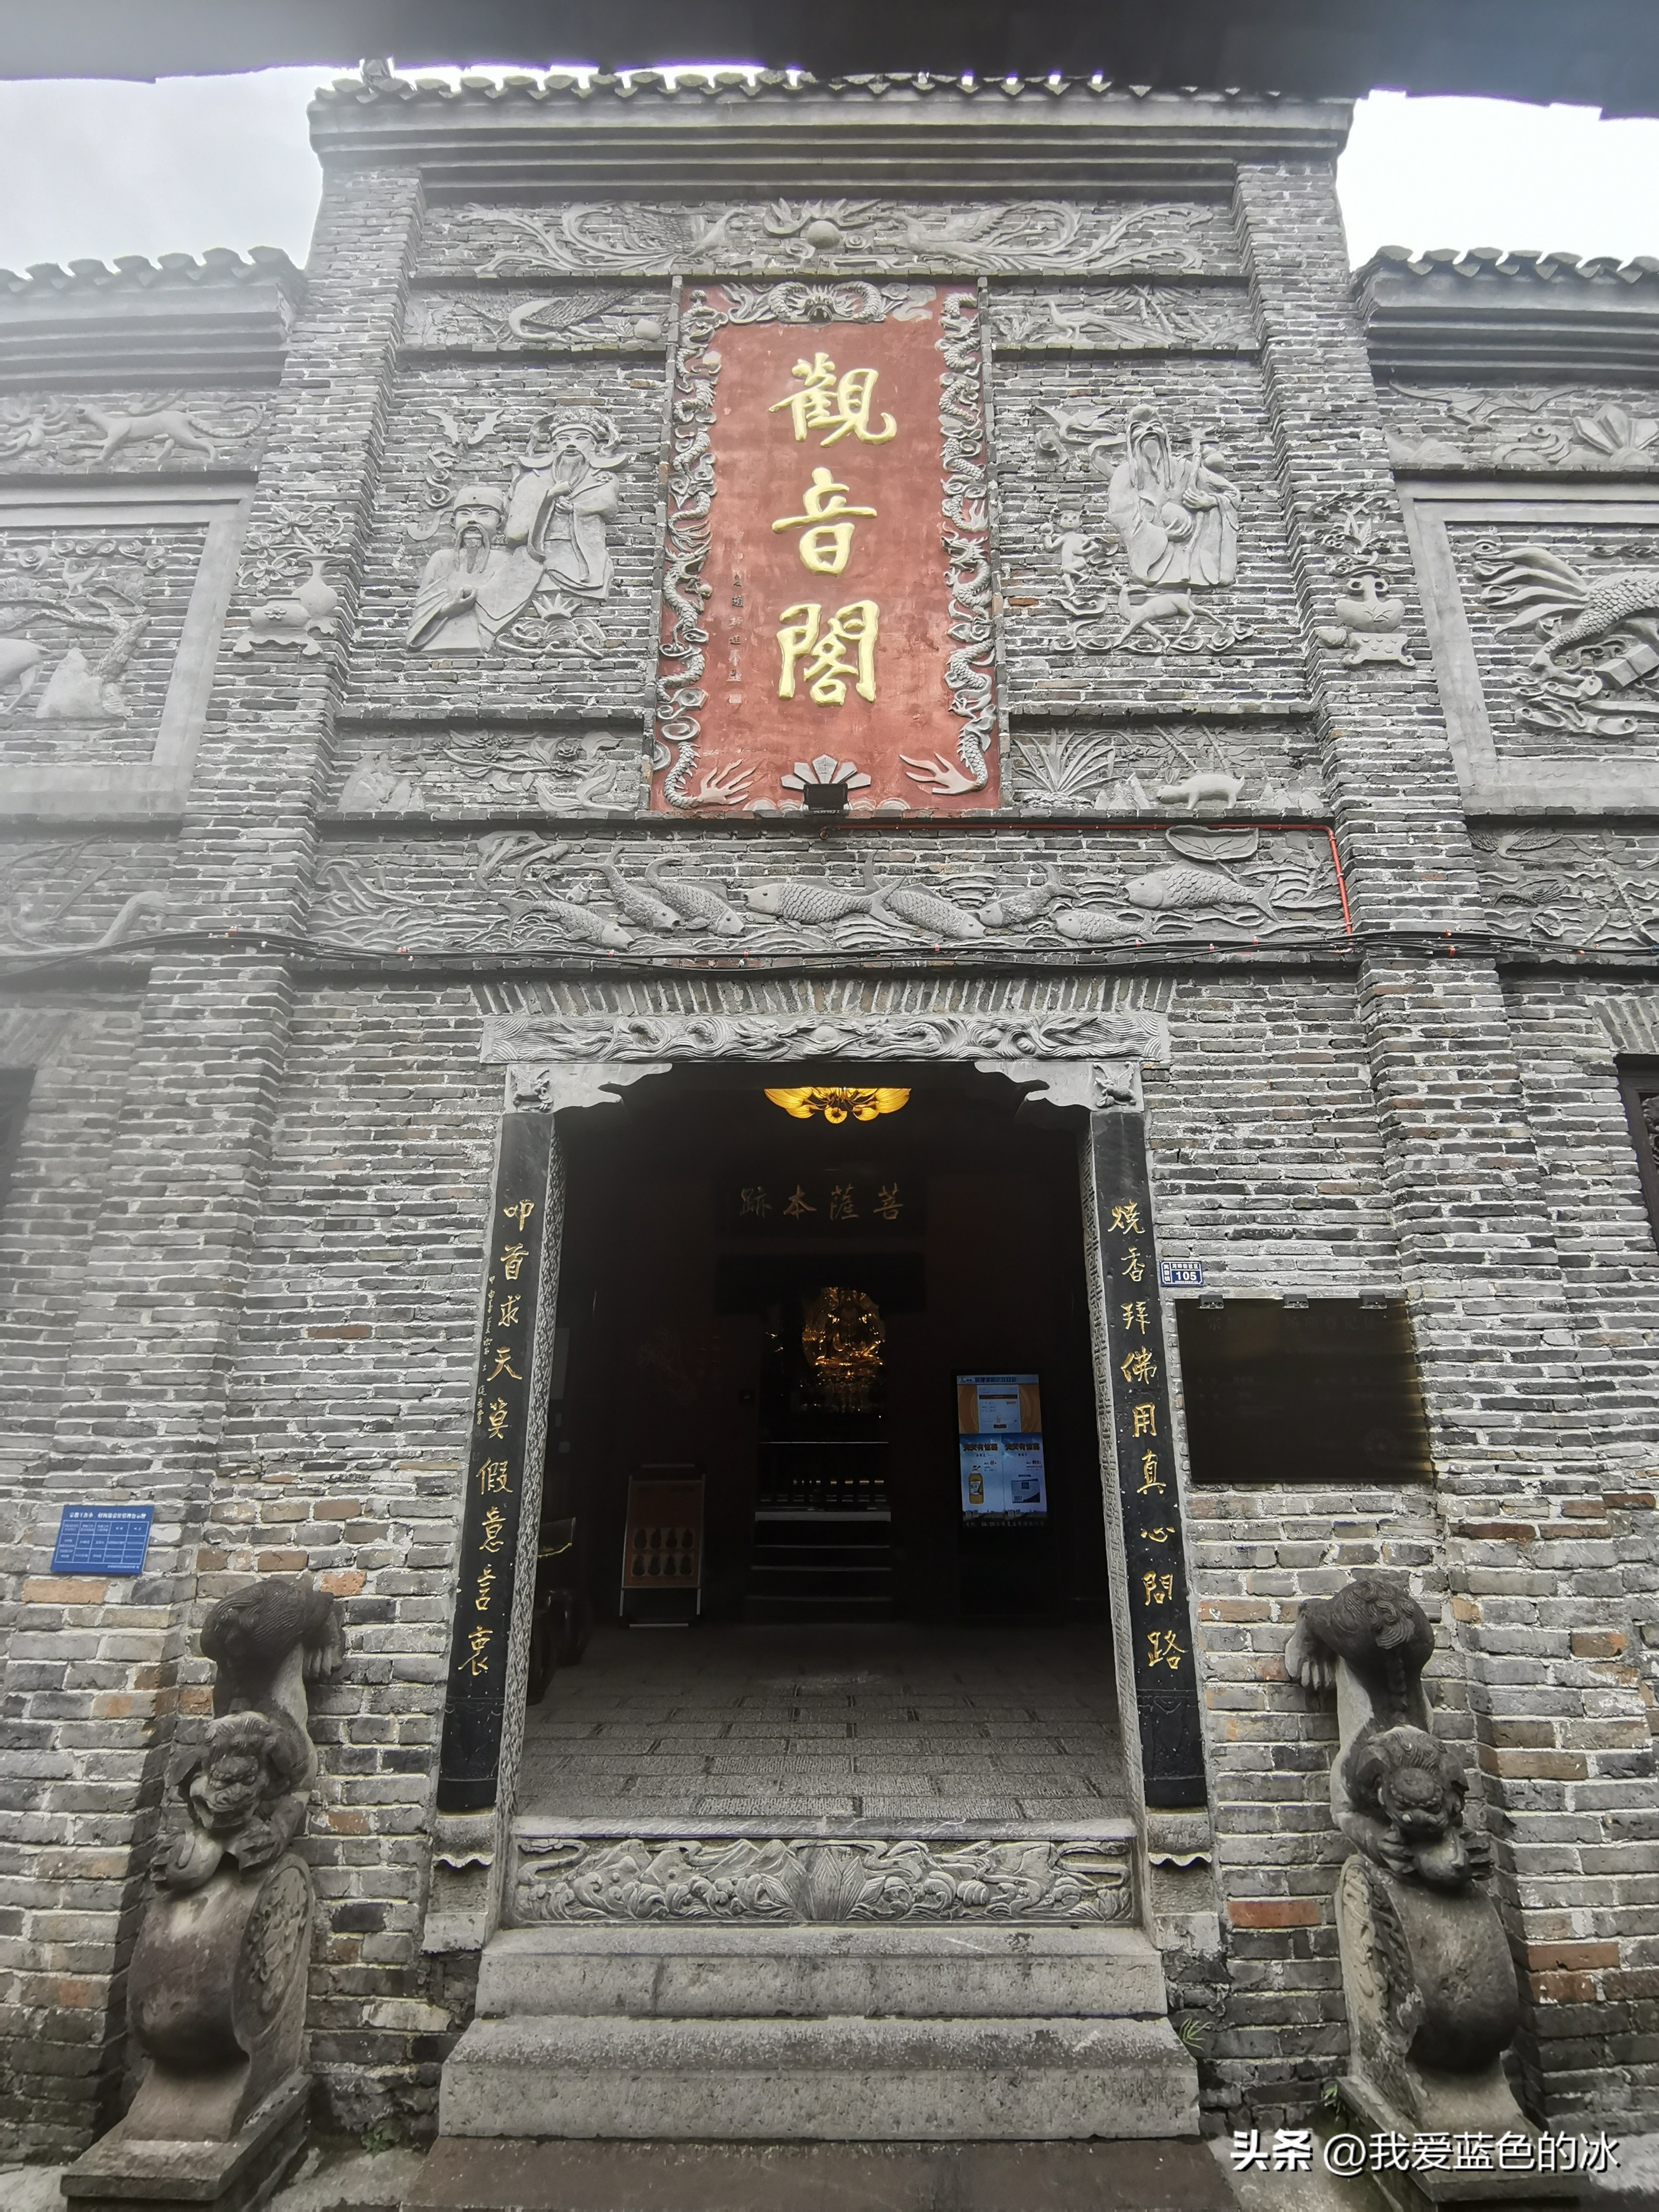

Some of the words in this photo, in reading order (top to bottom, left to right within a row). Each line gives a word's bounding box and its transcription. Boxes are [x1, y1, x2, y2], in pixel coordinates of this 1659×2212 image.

[767, 352, 898, 707] 觀音閣
[1176, 1271, 1197, 1281] 105
